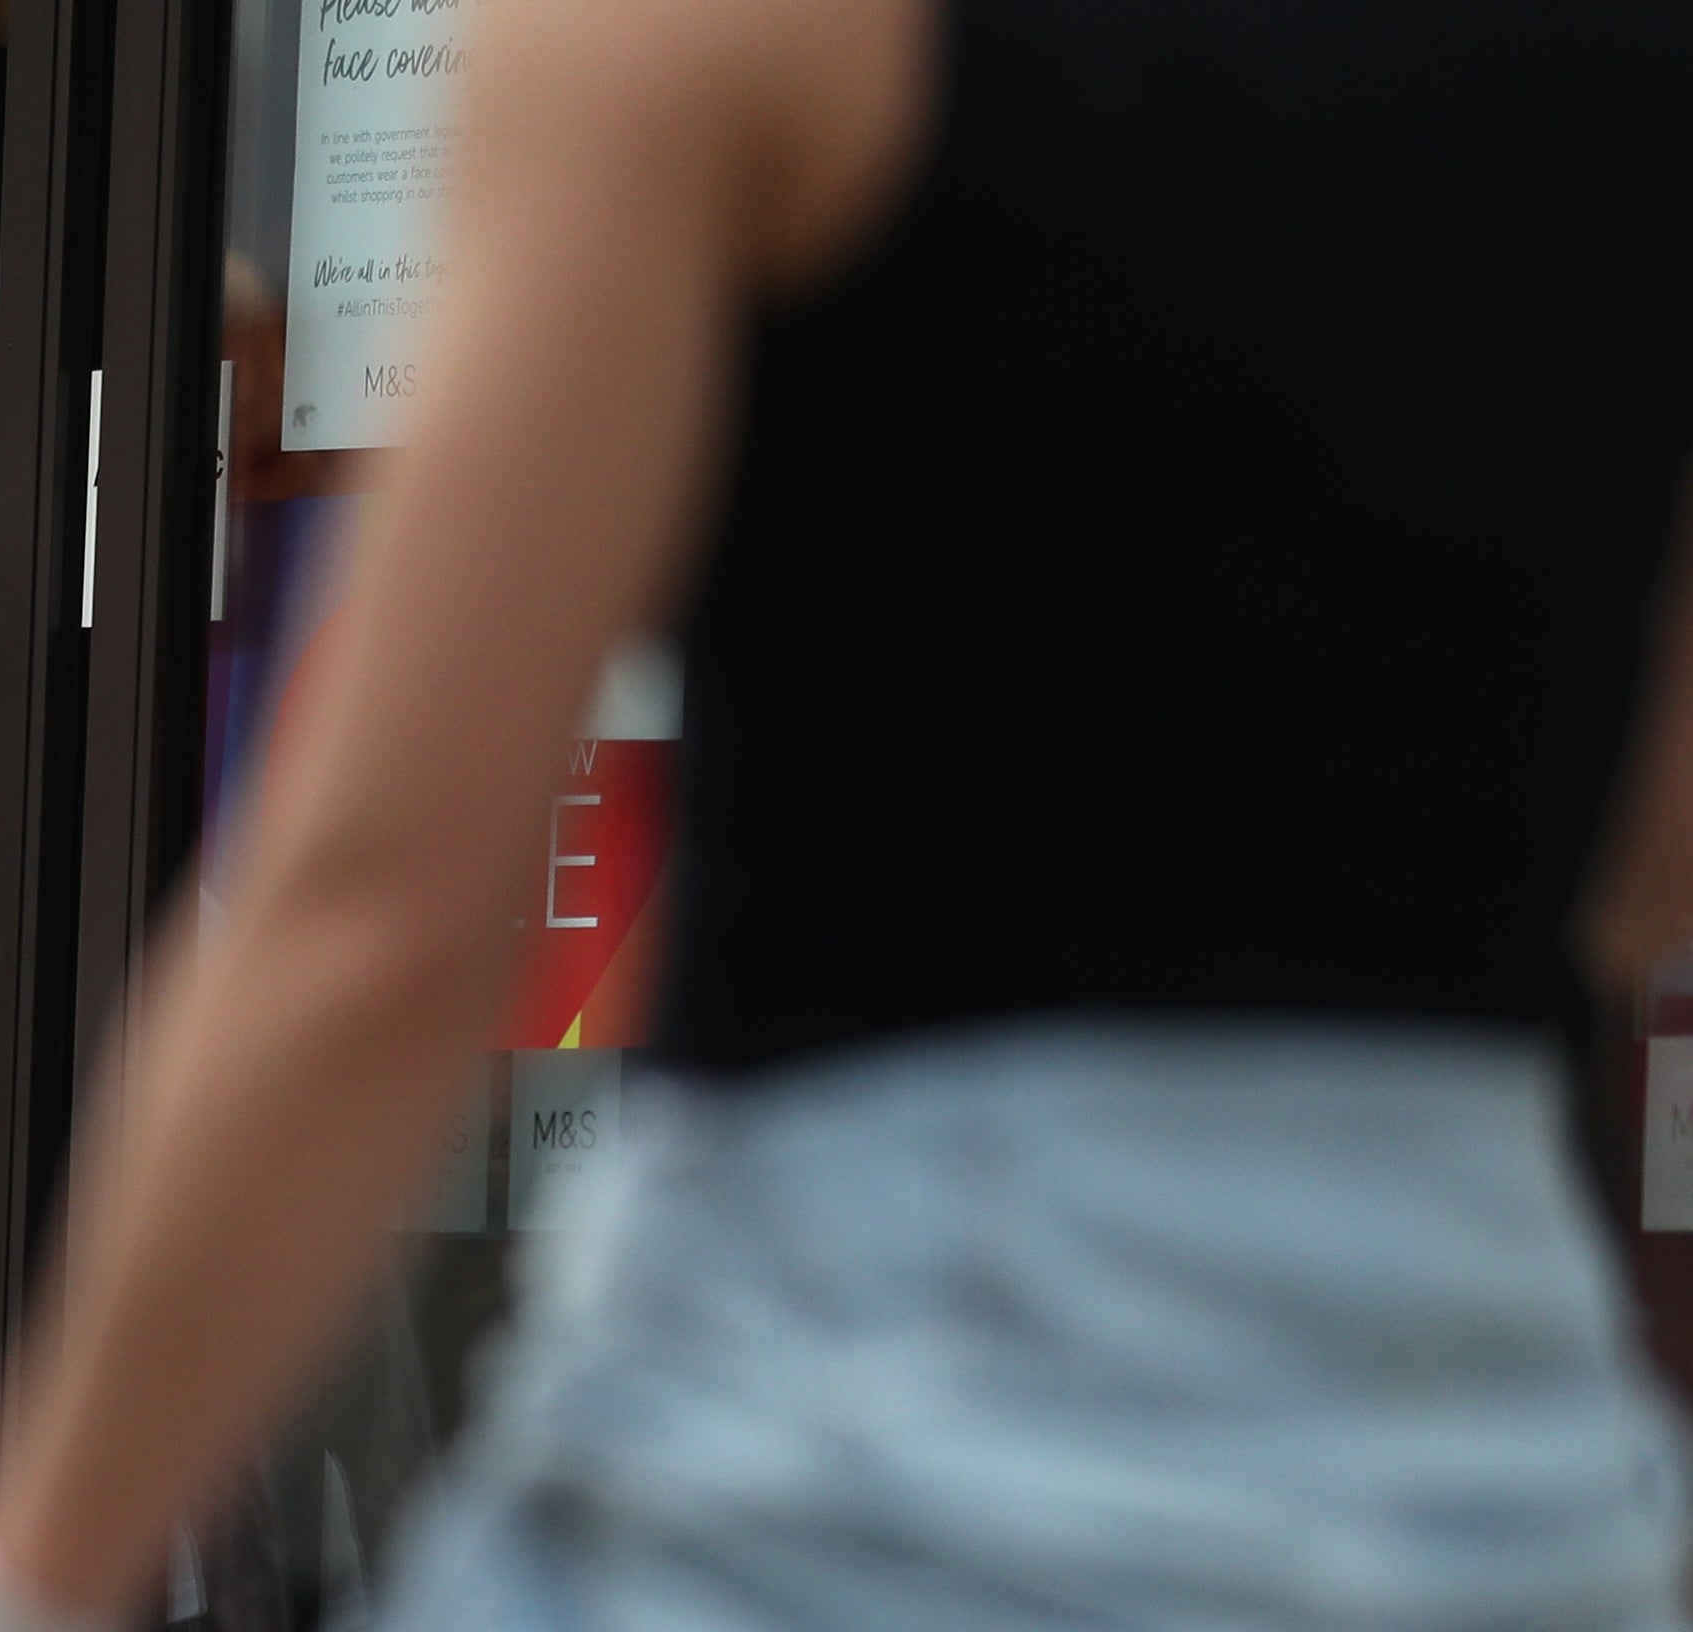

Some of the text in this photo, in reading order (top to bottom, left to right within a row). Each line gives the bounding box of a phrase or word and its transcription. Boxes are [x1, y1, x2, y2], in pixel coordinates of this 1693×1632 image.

[323, 38, 379, 86] face
[333, 132, 349, 144] line
[353, 130, 371, 142] with
[374, 127, 430, 144] government
[329, 153, 341, 164] we
[345, 149, 377, 165] politely
[381, 146, 416, 163] request
[419, 145, 438, 159] that
[327, 171, 373, 185] customers
[377, 169, 399, 181] wear
[401, 169, 408, 181] a
[411, 165, 431, 178] face
[332, 190, 357, 203] whilst
[361, 187, 403, 203] shopping
[406, 185, 415, 198] in
[314, 255, 354, 288] We're
[357, 259, 374, 282] all
[378, 260, 390, 280] in
[396, 253, 420, 284] this
[364, 364, 418, 398] M&S
[532, 1110, 597, 1150] M&S
